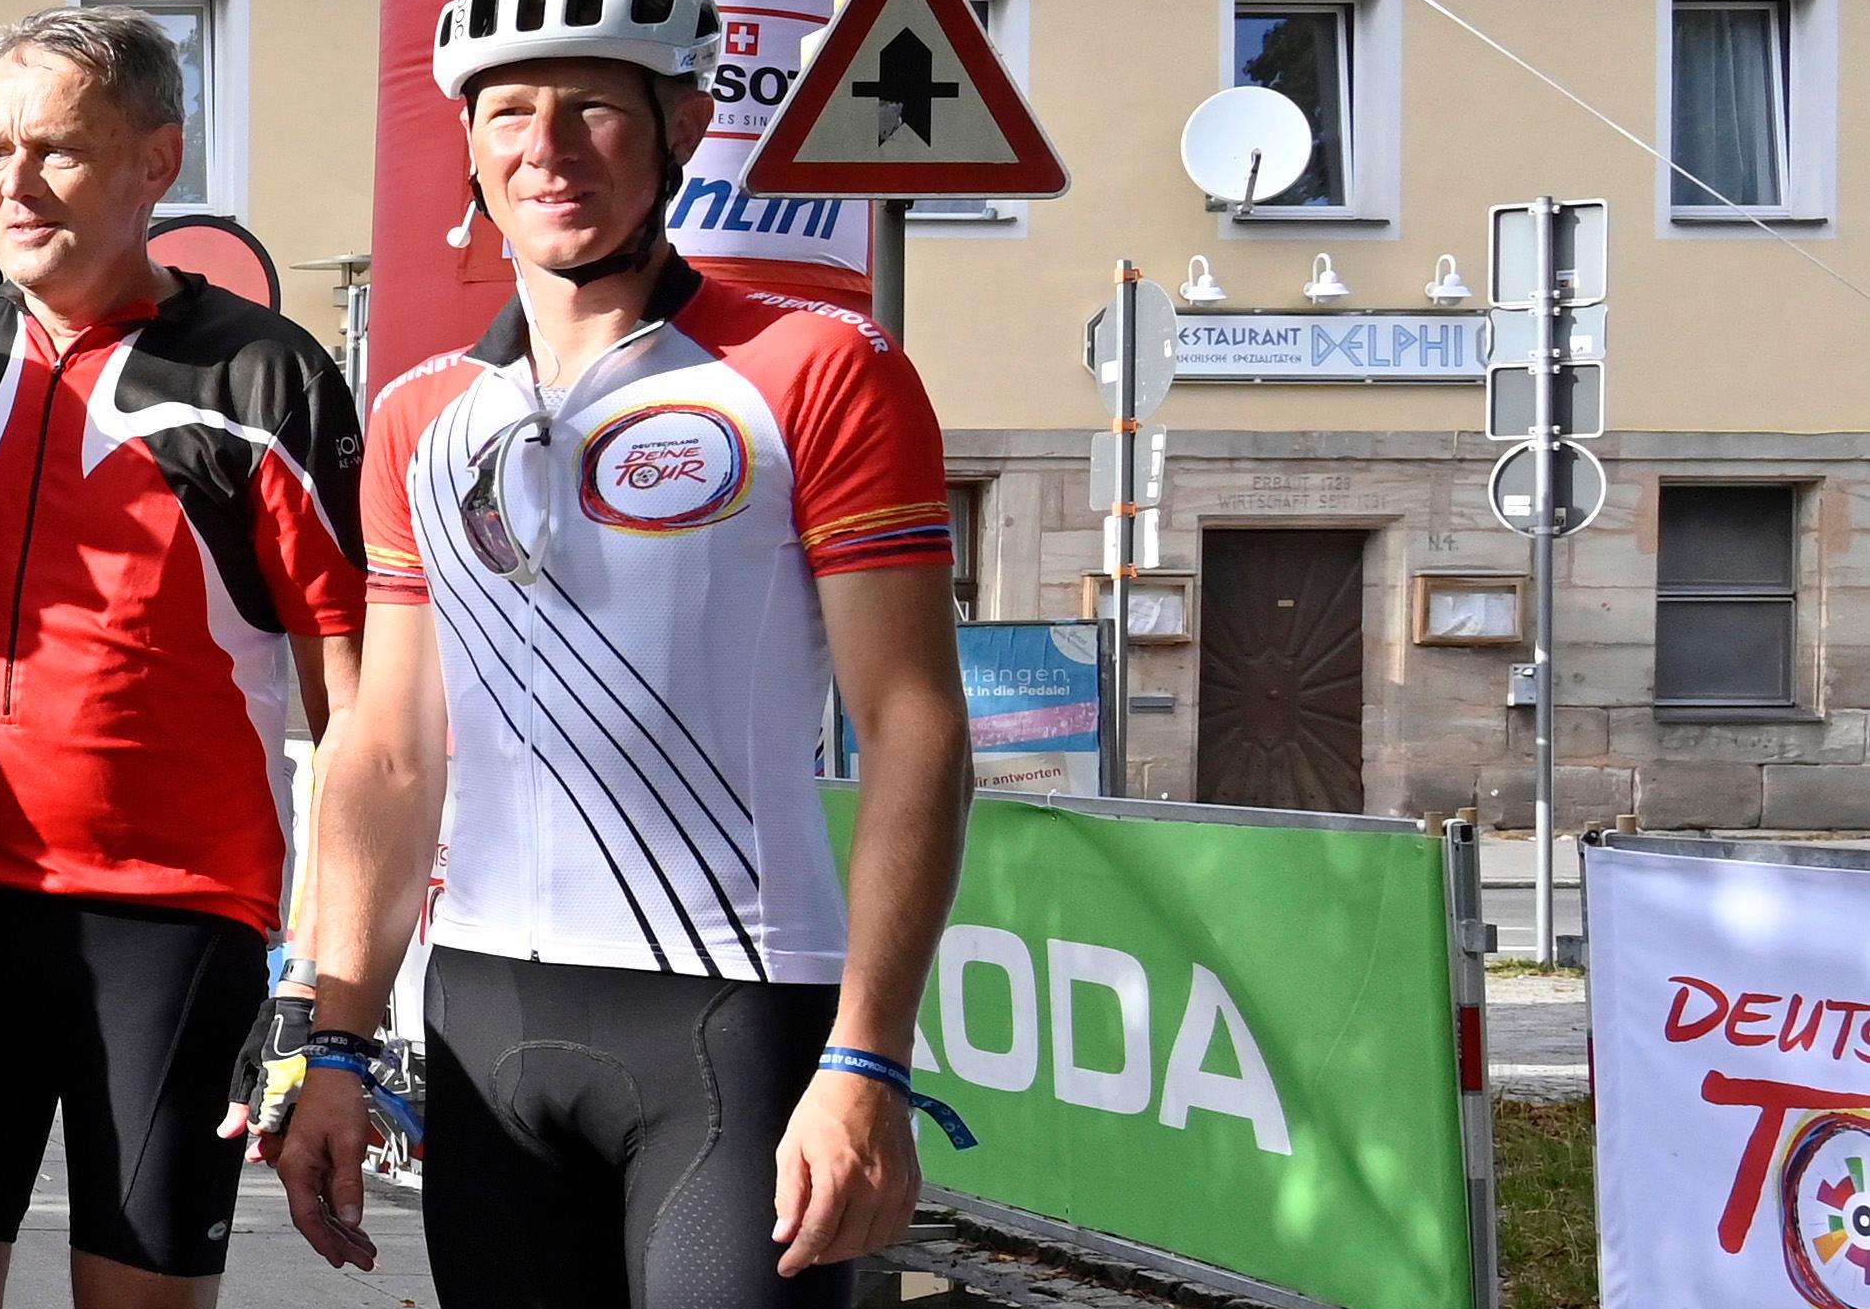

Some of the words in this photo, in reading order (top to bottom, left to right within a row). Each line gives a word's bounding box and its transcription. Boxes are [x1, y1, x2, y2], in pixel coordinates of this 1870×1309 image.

[743, 115, 768, 126] SIN
[746, 292, 889, 353] #DEINETOUR
[1178, 328, 1301, 346] ESTAURANT
[1311, 325, 1462, 367] DELPHI
[624, 447, 702, 464] DEINE
[615, 460, 706, 489] TOUR
[1253, 476, 1309, 491] ERBAUT
[1219, 494, 1309, 509] WIRTSCHAFT
[963, 666, 1071, 686] rlangen,
[978, 686, 990, 696] in
[993, 686, 1015, 696] die
[993, 766, 1061, 786] antworten
[925, 924, 1292, 1155] ODA
